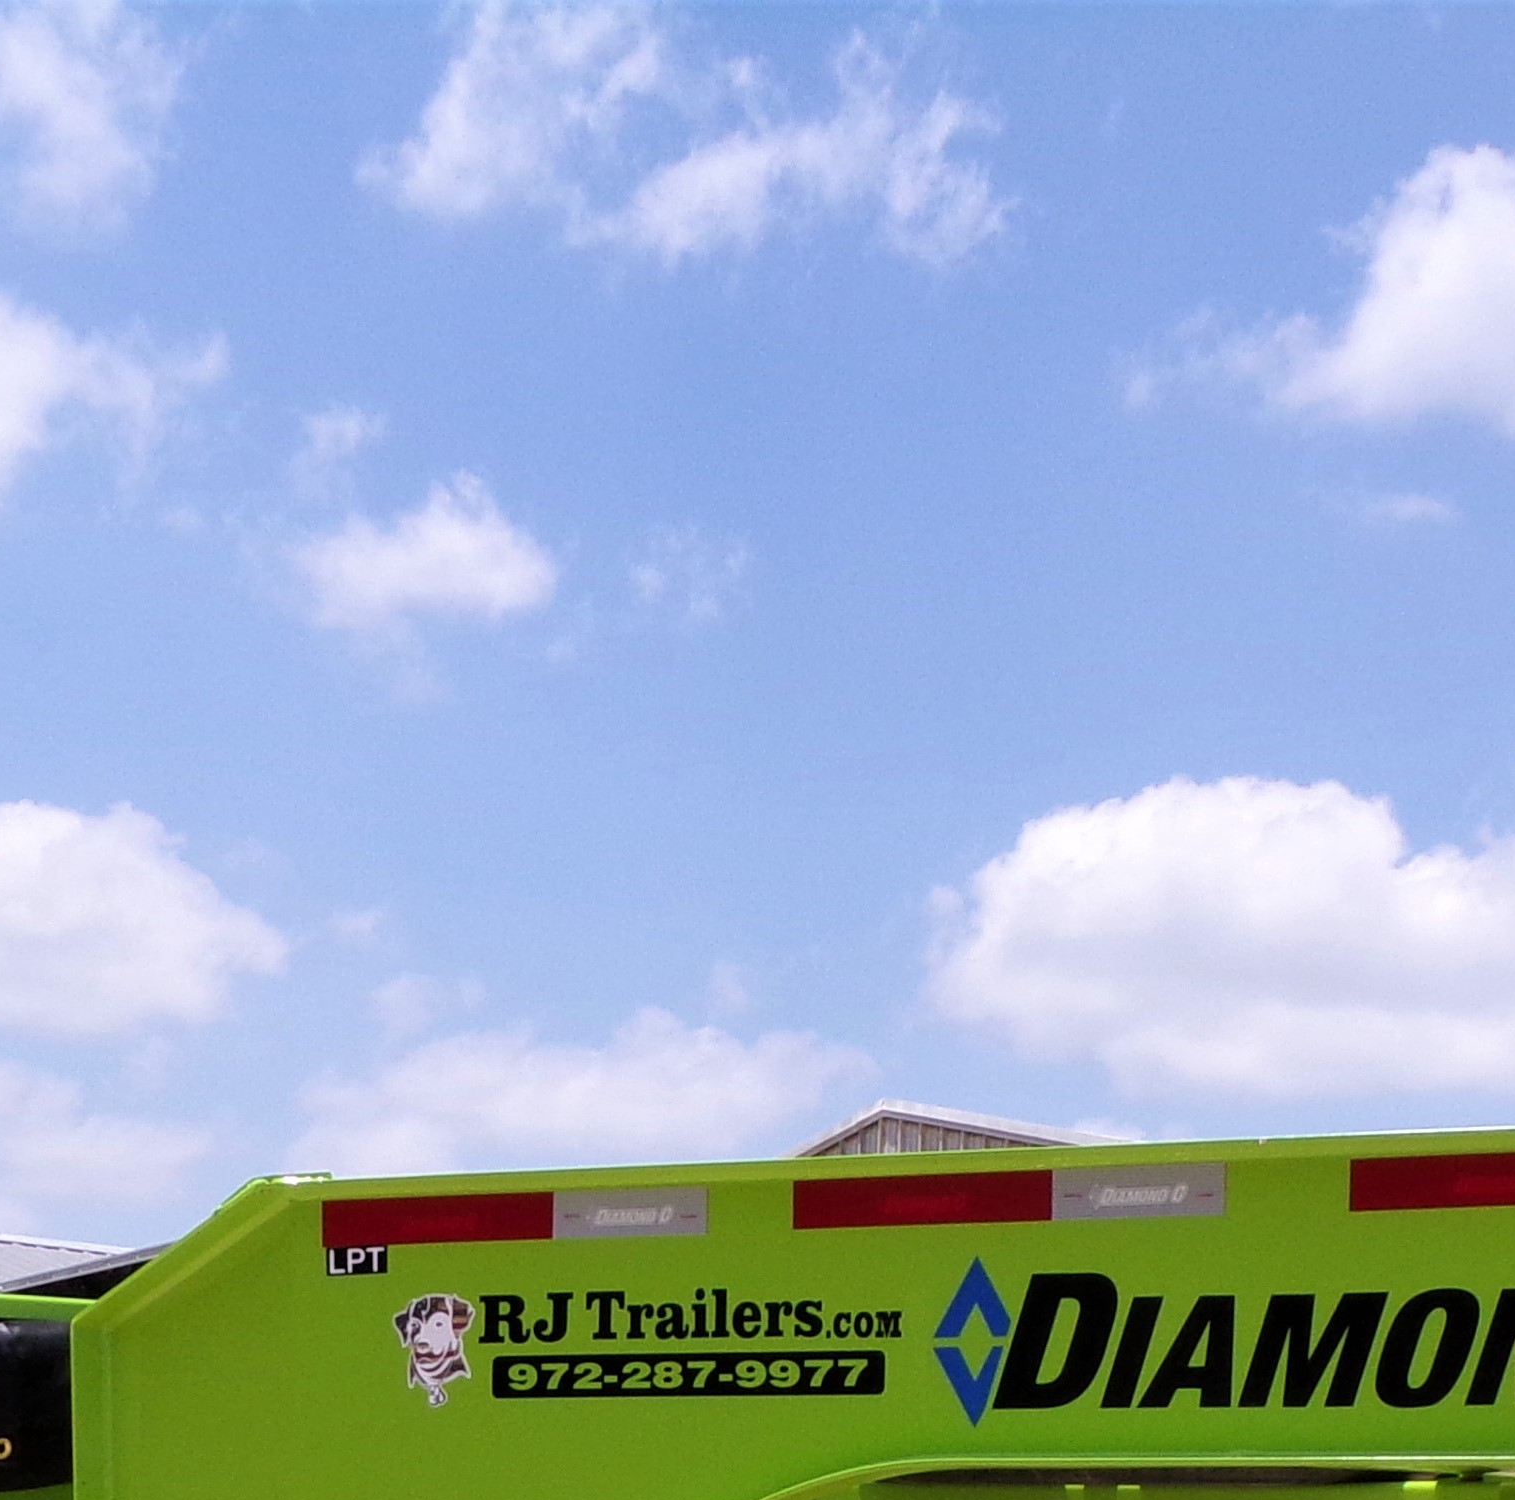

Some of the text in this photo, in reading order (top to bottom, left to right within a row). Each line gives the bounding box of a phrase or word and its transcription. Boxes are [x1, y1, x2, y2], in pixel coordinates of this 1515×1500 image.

[329, 1246, 385, 1274] LPT
[478, 1292, 574, 1344] RJ
[507, 1358, 869, 1391] 972-287-9977
